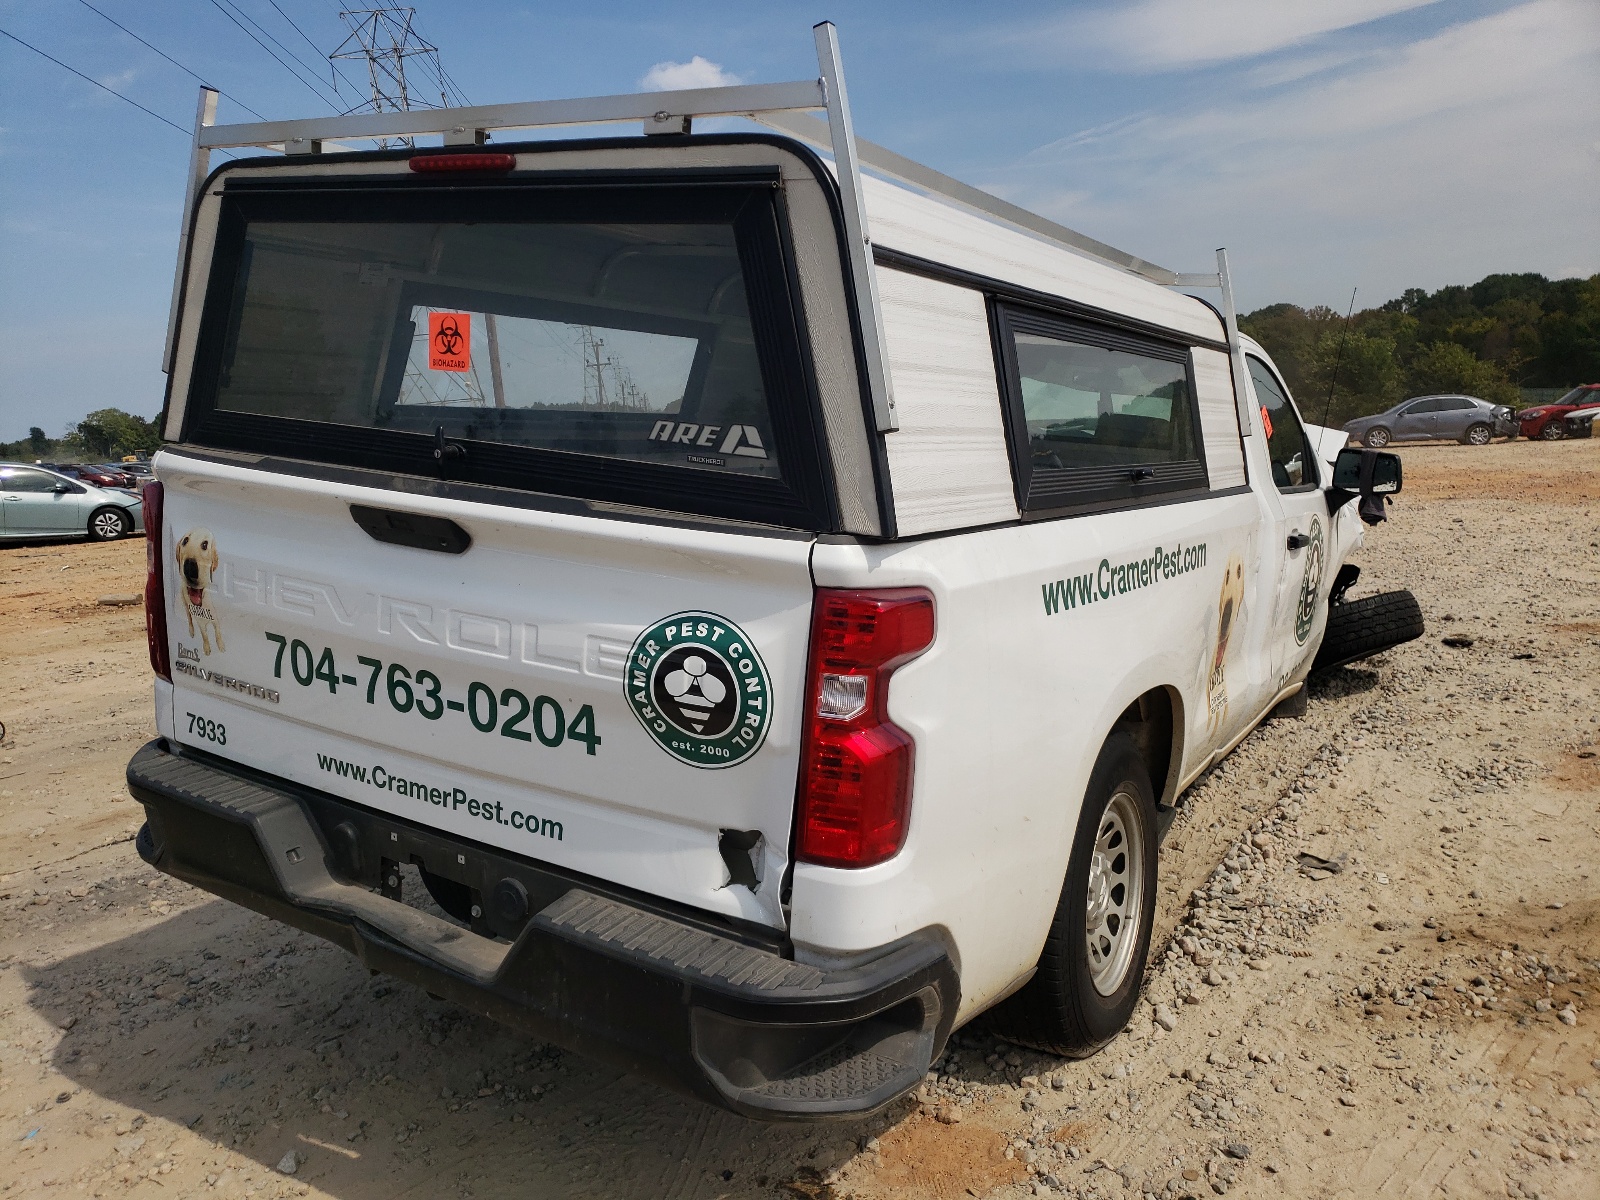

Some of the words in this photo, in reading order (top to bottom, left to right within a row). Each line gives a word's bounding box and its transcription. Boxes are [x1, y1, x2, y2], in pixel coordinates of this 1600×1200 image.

[432, 359, 466, 369] BIOHAZARD
[648, 420, 721, 447] ARE
[1042, 542, 1207, 616] www.CramerPest.com
[210, 561, 637, 682] HEVROLE
[175, 660, 280, 704] SILVERADO
[265, 631, 602, 756] 704-763-0204
[633, 639, 667, 734] CRAMER
[665, 622, 725, 642] PEST
[728, 642, 762, 748] CONTROL
[186, 711, 227, 746] 7933
[671, 740, 696, 751] est.
[700, 744, 730, 758] 2000
[317, 752, 564, 841] www.CramerPest.com
